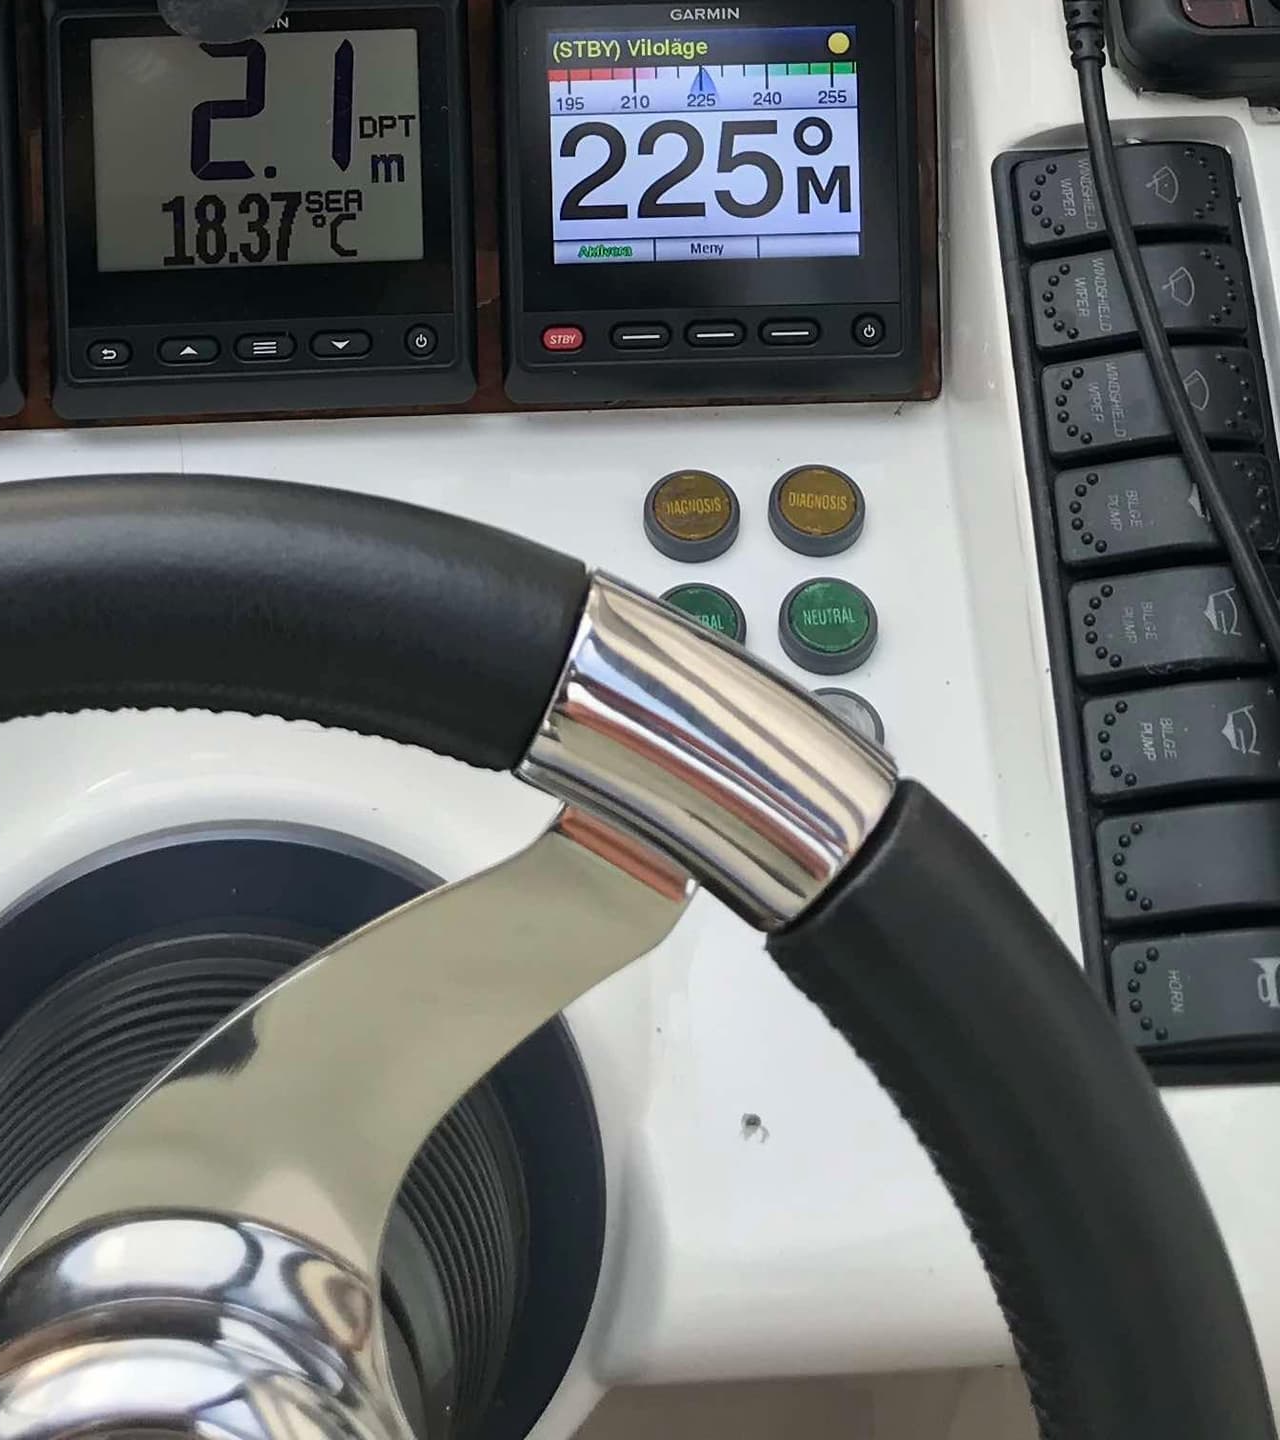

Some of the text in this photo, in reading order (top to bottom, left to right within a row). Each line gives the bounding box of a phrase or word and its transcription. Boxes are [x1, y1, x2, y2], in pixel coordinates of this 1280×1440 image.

[670, 7, 740, 21] GARMIN
[552, 36, 708, 62] (STBY) Viloläge
[190, 38, 354, 181] 2.1
[556, 89, 847, 111] 195 210 225 240 255
[359, 114, 416, 138] DPT
[370, 153, 405, 183] m
[305, 189, 363, 212] SEA
[1059, 177, 1076, 217] WIPER
[161, 191, 302, 266] 18.37
[578, 243, 633, 258] Aktivera
[691, 242, 724, 257] Meny
[1074, 277, 1090, 318] WIPER
[1092, 257, 1112, 332] WINDSHIELD
[549, 334, 577, 346] STBY
[1106, 362, 1127, 438] WINDSHIELD
[788, 491, 848, 511] DIAGNOSIS
[803, 607, 856, 626] NEUTRAL
[1140, 721, 1157, 763] PUMP
[1158, 716, 1178, 761] BILGE
[1167, 968, 1185, 1014] HORN
